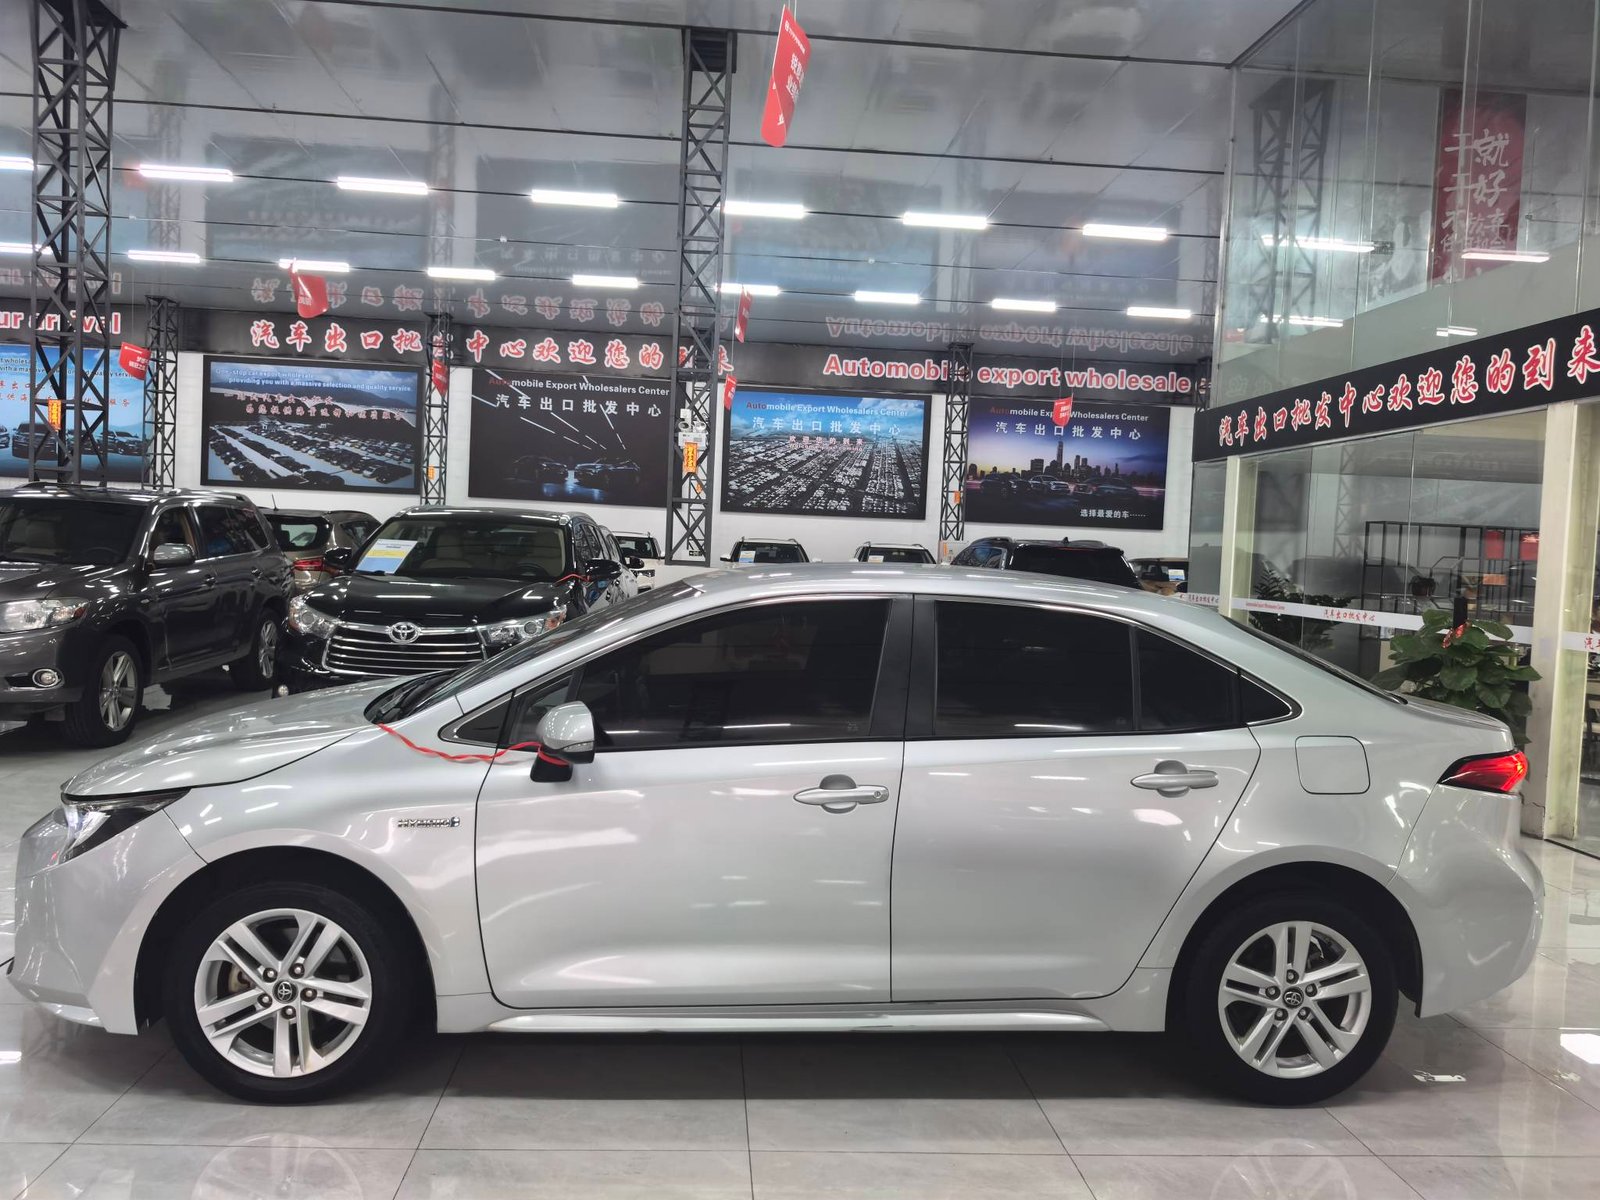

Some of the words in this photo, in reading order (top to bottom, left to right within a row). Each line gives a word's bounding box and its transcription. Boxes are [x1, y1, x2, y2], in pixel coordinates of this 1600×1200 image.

[489, 377, 544, 389] Automobile
[545, 380, 577, 391] Export
[579, 382, 637, 394] Wholesalers
[638, 385, 670, 396] Center
[977, 366, 1061, 387] export
[1065, 367, 1191, 393] wholesale
[1218, 325, 1600, 448] 汽车出口批发中心欢迎您的到来
[496, 393, 662, 417] 汽车出口批发中心
[746, 401, 795, 411] Automobile
[797, 403, 827, 414] Export
[827, 405, 879, 416] Wholesalers
[880, 408, 908, 417] Center
[990, 406, 1039, 417] Automobile
[1069, 411, 1120, 421] Wholesalers
[1121, 412, 1149, 422] Center
[752, 416, 901, 436] 汽车出口批发中心
[996, 421, 1141, 440] 汽车出口批发中心
